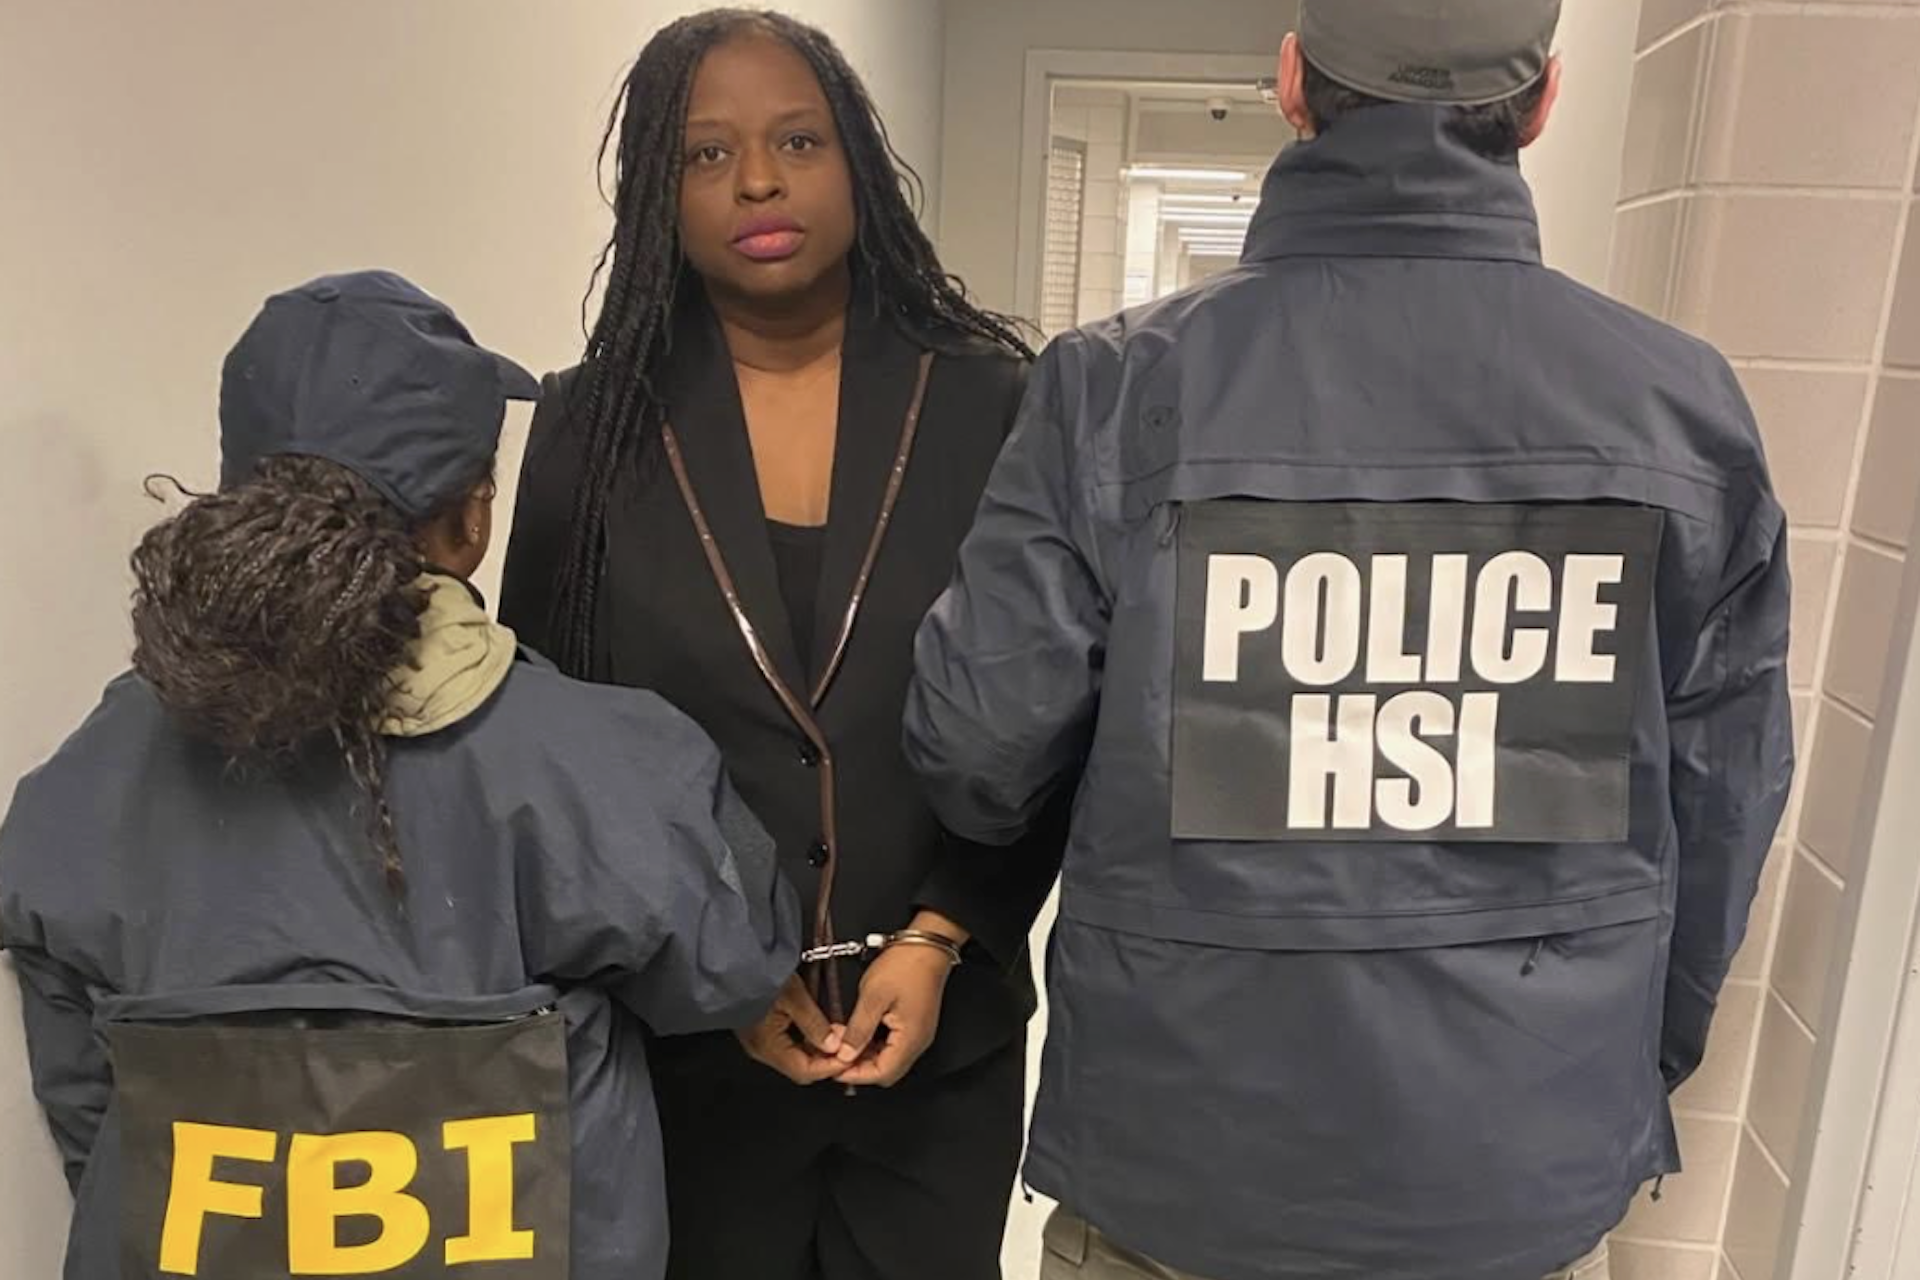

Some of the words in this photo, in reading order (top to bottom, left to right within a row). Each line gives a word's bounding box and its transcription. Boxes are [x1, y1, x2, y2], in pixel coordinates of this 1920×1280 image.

[1203, 551, 1624, 685] POLICE
[1287, 691, 1499, 831] HSI
[159, 1113, 536, 1276] FBI
